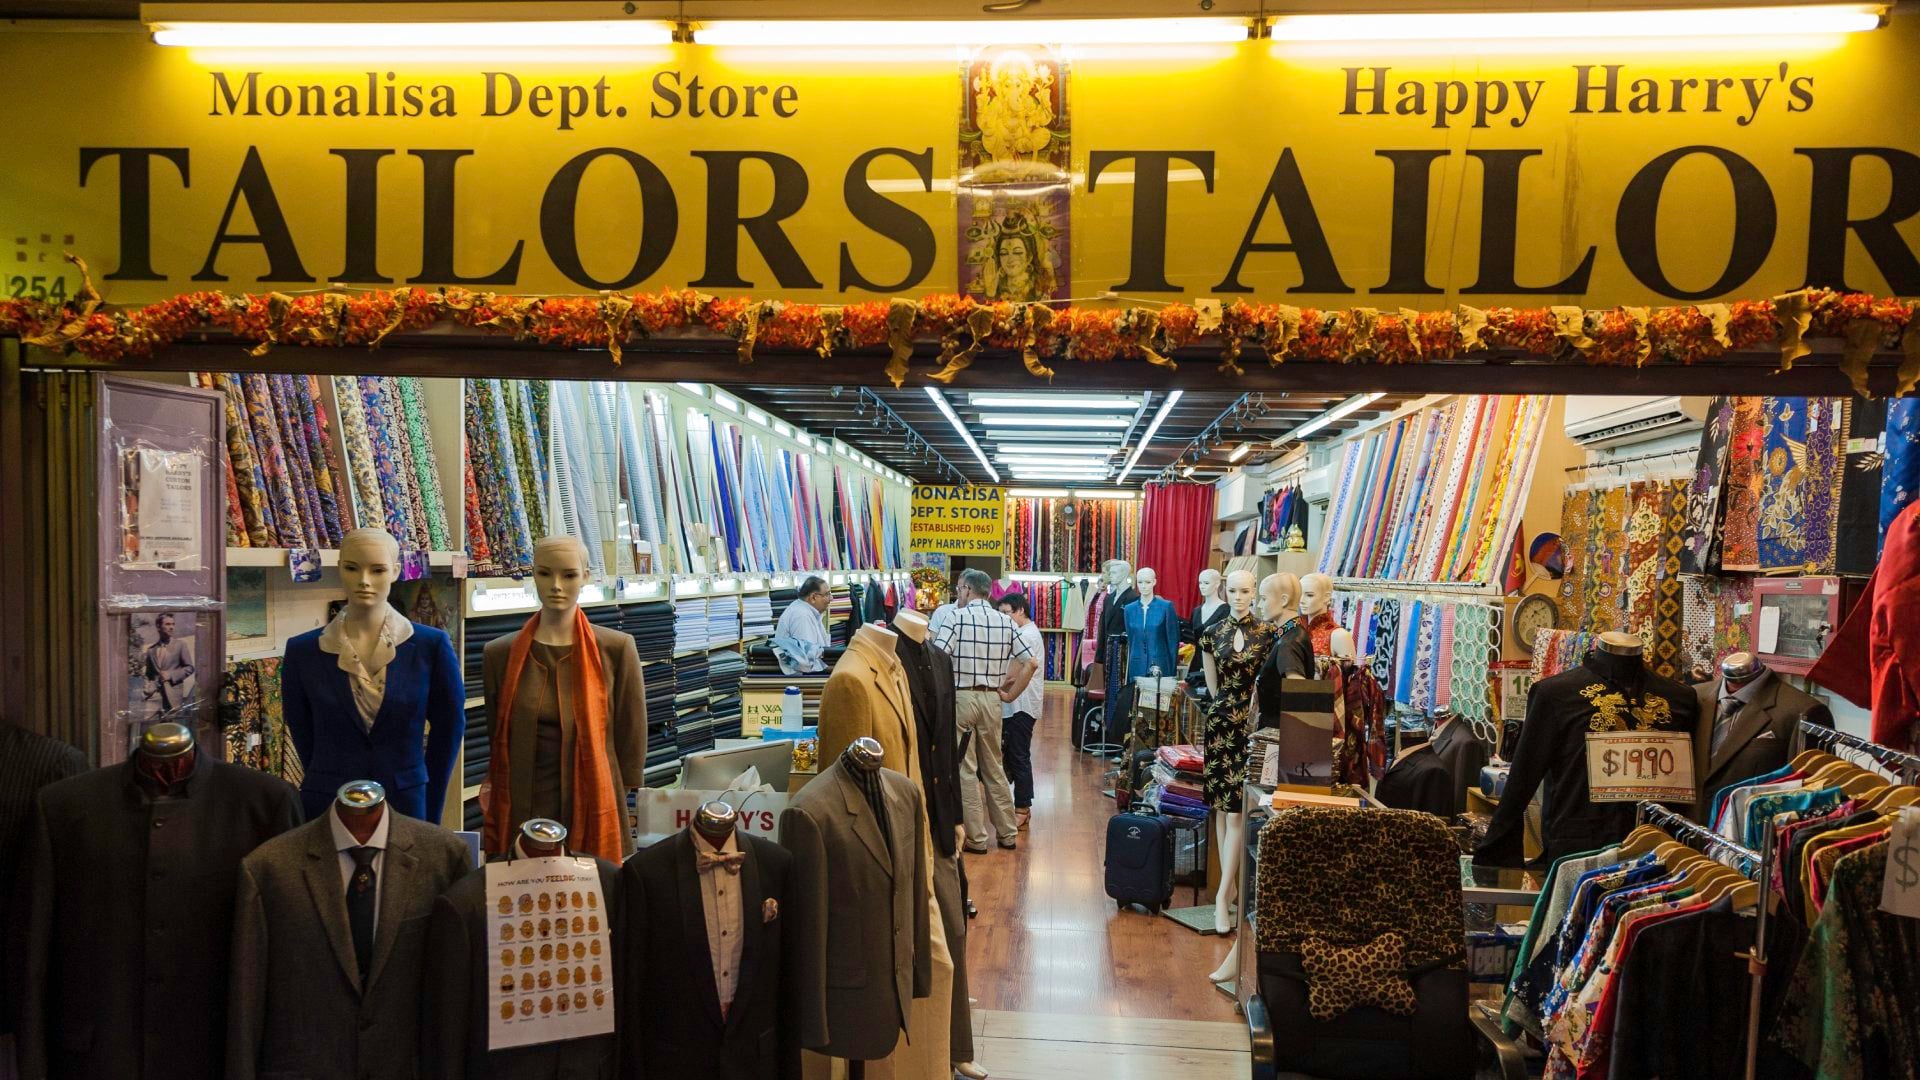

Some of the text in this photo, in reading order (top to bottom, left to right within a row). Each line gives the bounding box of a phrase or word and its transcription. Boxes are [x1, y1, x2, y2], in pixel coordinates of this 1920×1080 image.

[208, 70, 799, 130] Monalisa Dept. Store
[1338, 61, 1815, 129] Happy Harry's
[78, 145, 938, 293] TAILORS
[1088, 146, 1920, 300] TAILOR
[10, 275, 67, 304] 254
[951, 507, 999, 520] STORE
[973, 524, 994, 534] 1965)
[910, 537, 1001, 550] APPY HARRY'S SHOP
[762, 704, 783, 713] WA
[676, 809, 774, 831] HY'S
